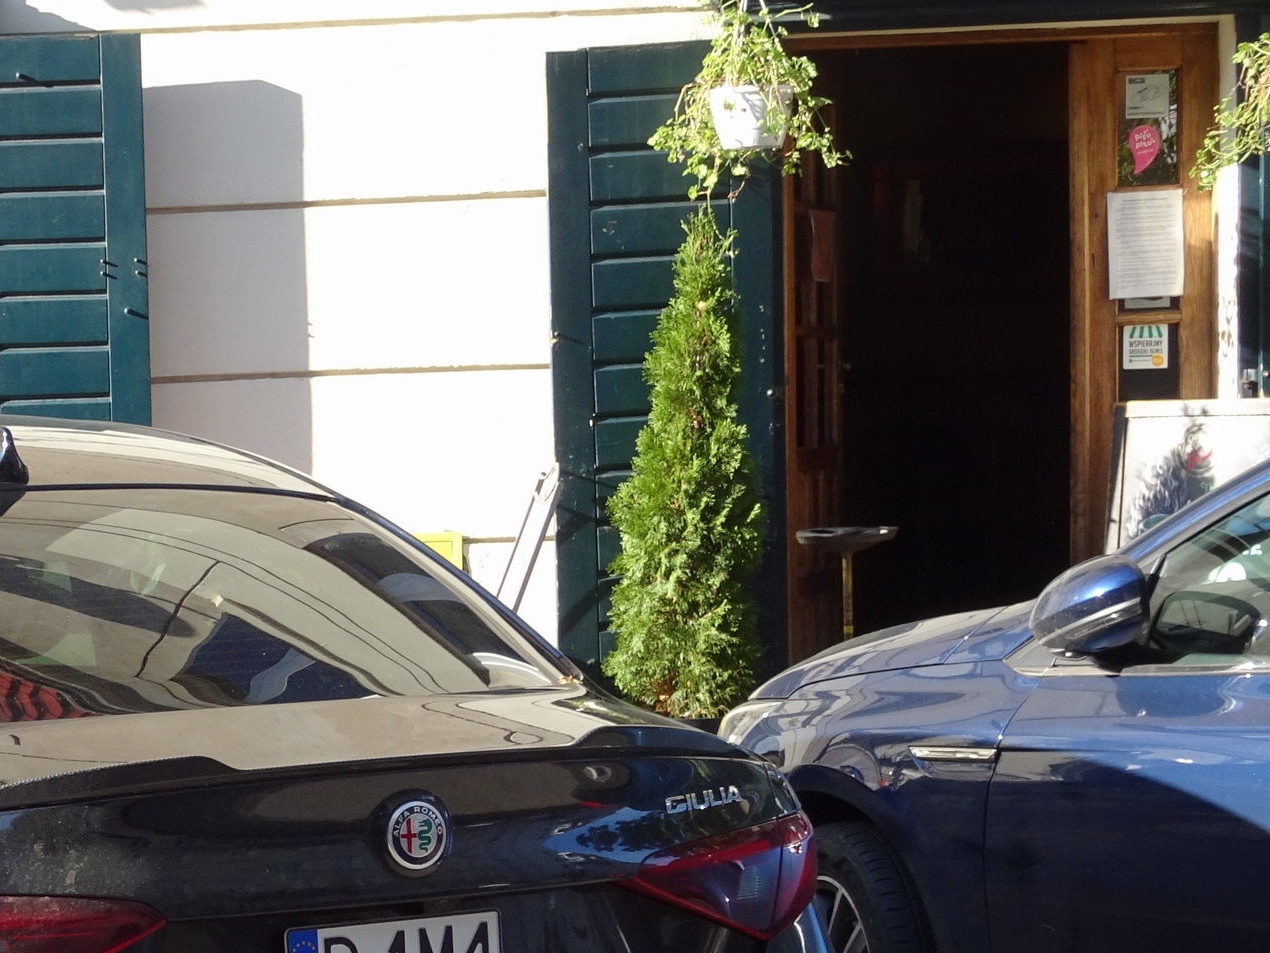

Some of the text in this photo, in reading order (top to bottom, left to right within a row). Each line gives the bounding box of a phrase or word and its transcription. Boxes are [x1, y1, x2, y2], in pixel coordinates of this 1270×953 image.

[665, 785, 743, 814] GIULIA
[393, 806, 443, 837] ALFA ROMEO
